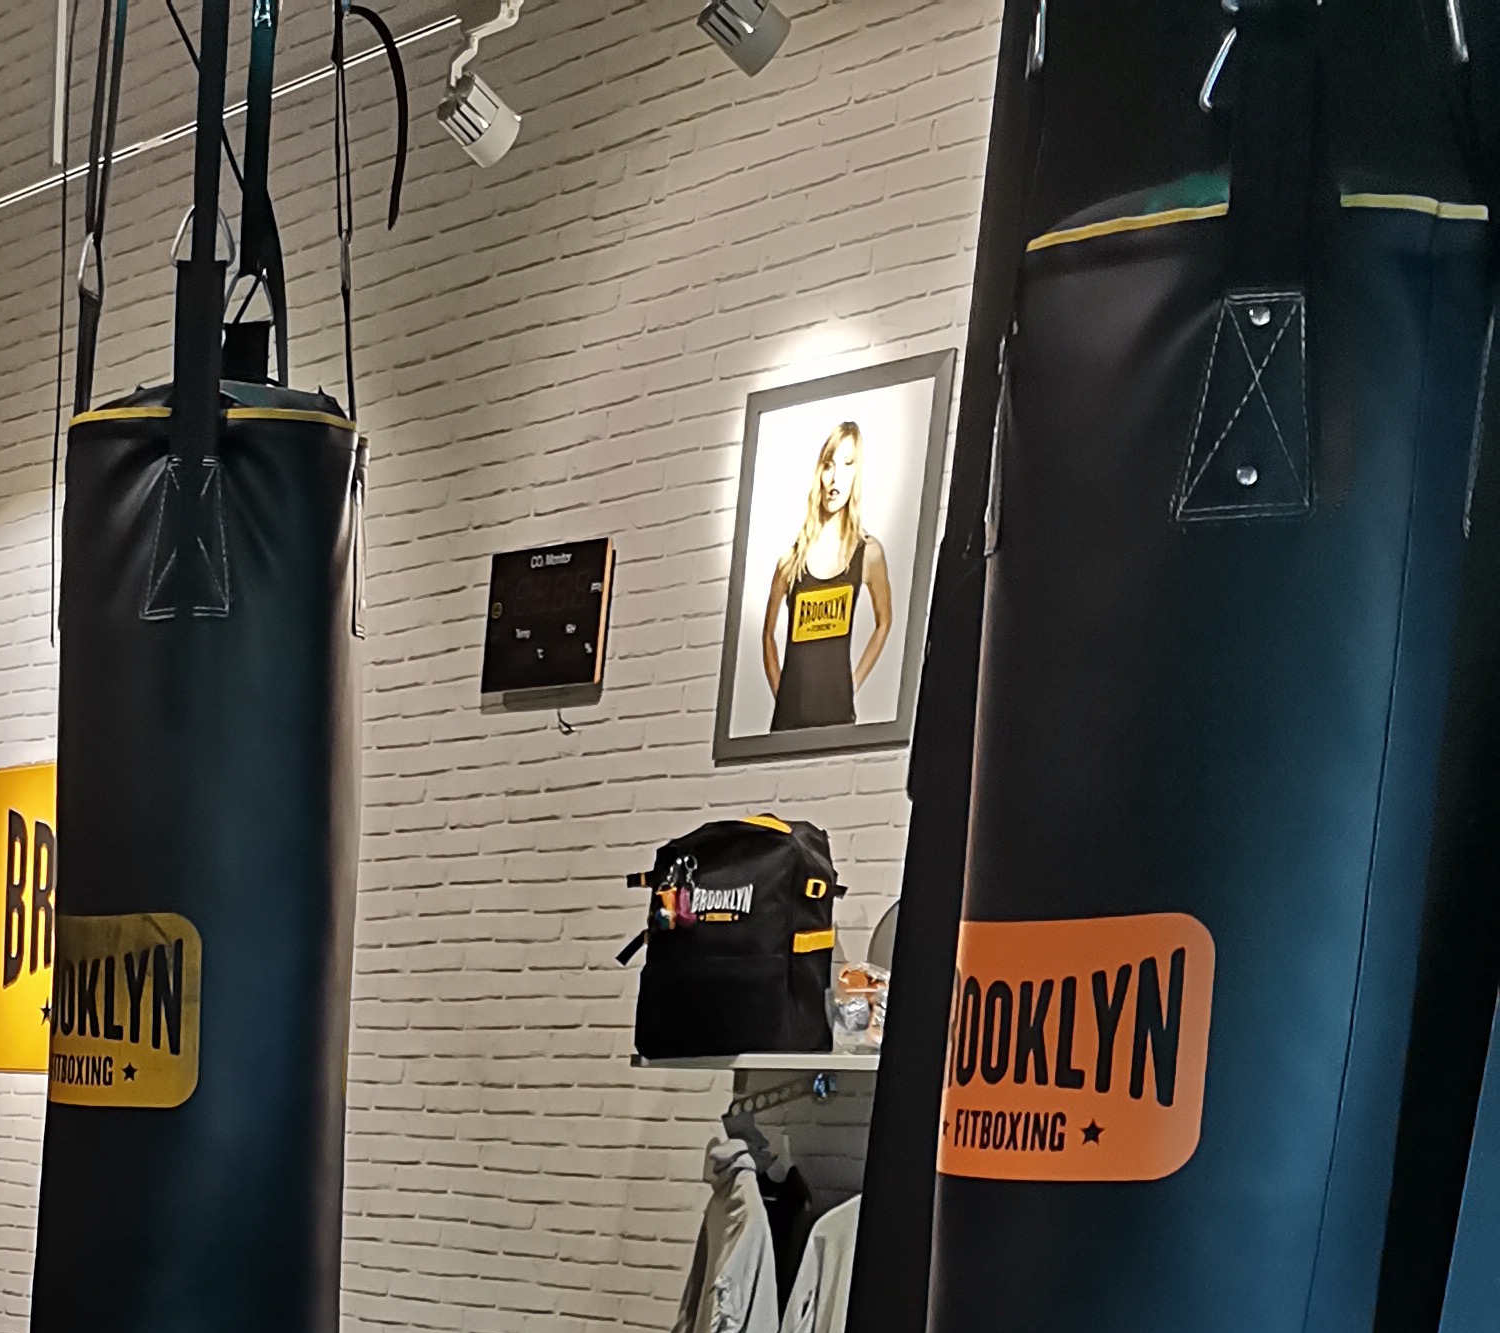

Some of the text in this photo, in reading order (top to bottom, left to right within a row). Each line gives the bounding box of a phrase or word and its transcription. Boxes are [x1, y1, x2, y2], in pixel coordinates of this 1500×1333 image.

[798, 592, 849, 628] BROOKLYN
[690, 883, 754, 914] BROOKLYN
[947, 947, 1186, 1107] OOKLYN
[954, 1109, 1067, 1152] FITBOXING
